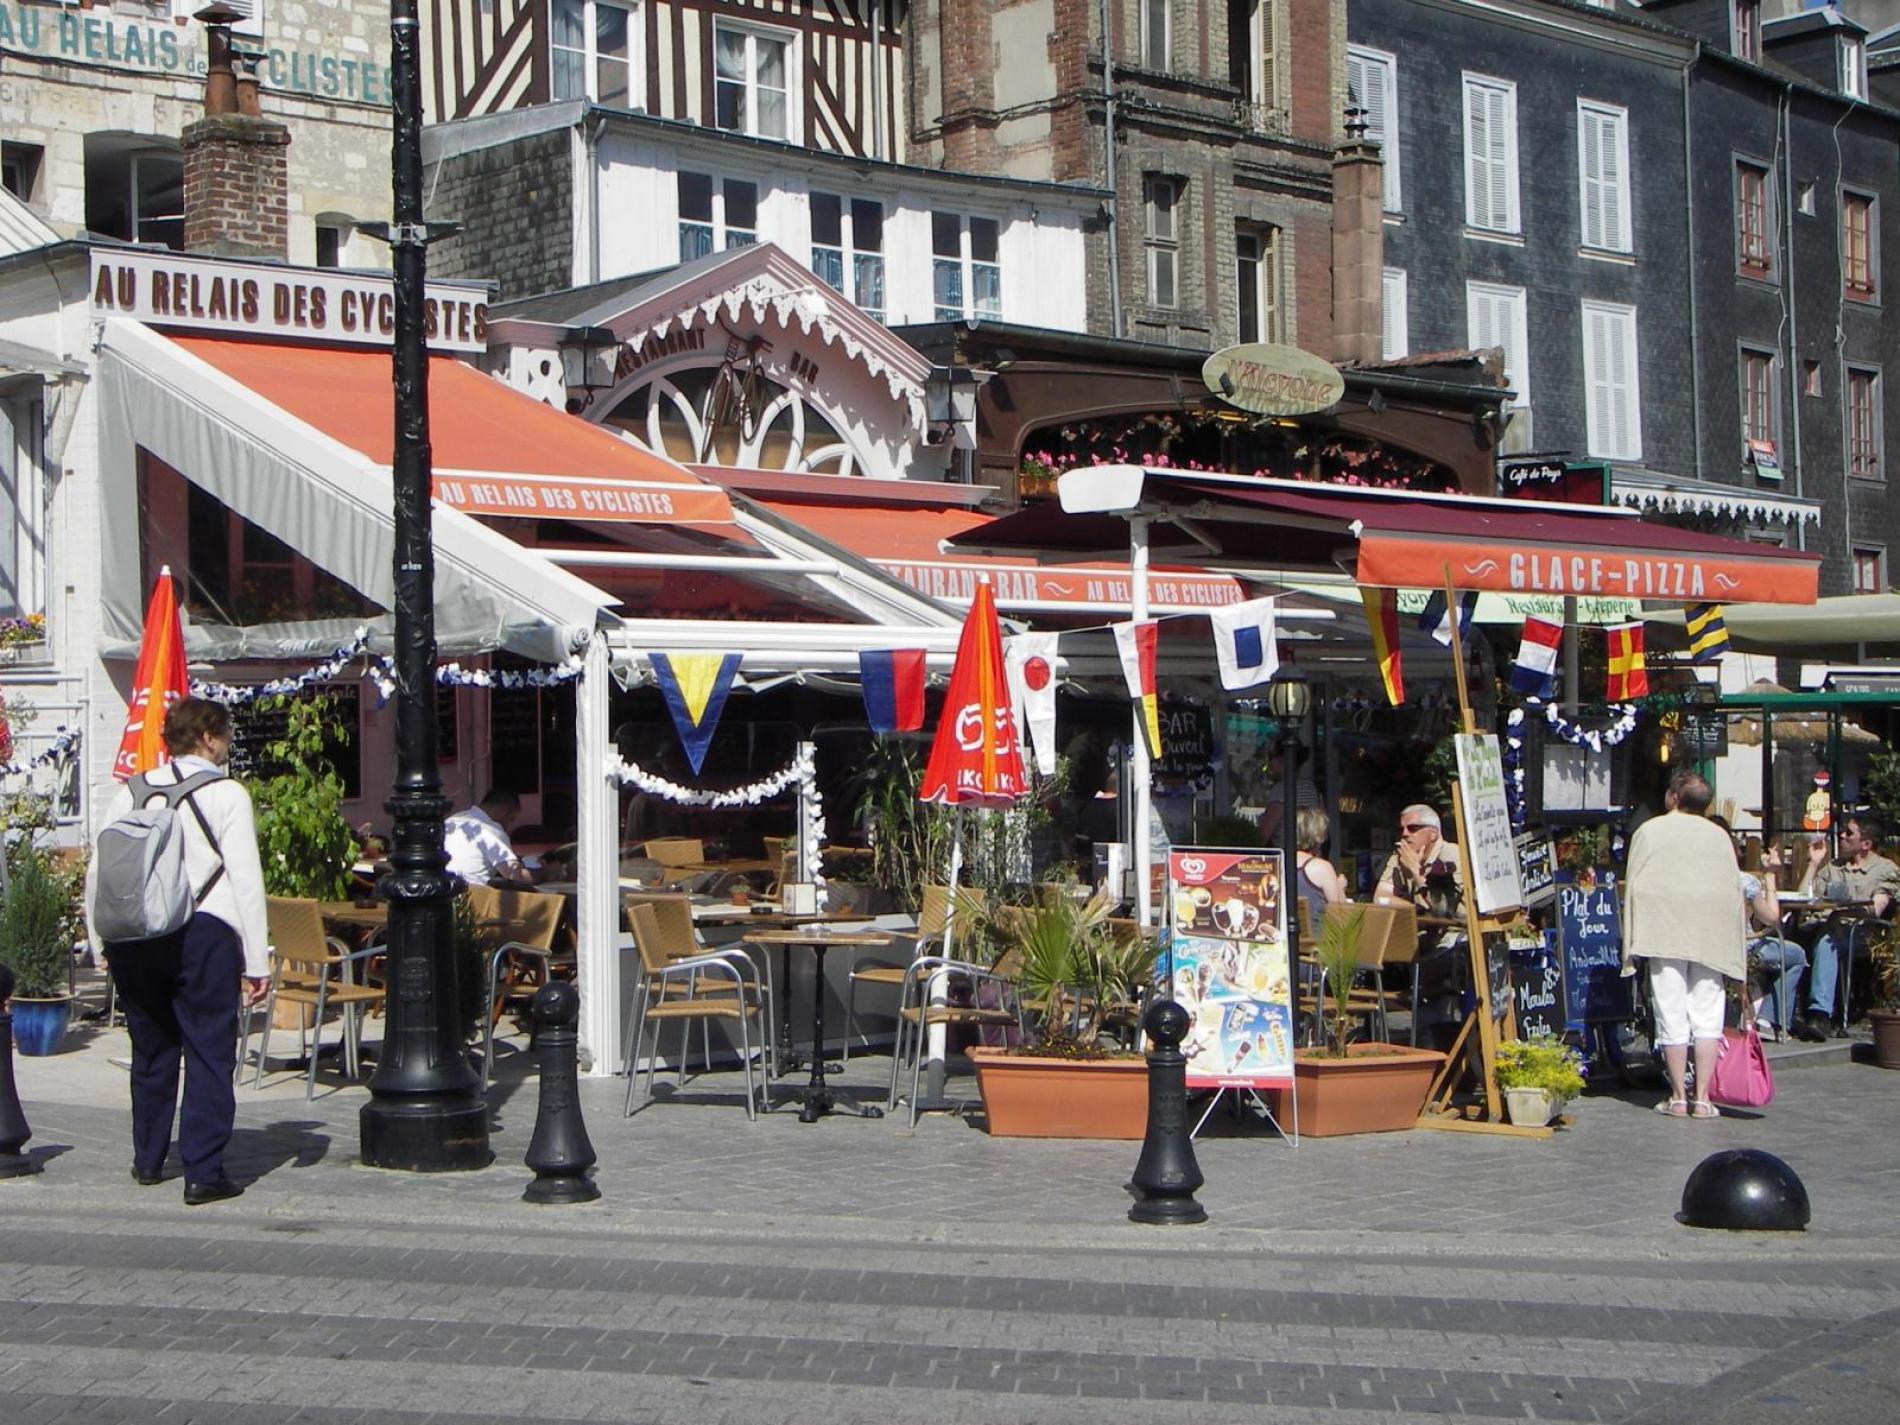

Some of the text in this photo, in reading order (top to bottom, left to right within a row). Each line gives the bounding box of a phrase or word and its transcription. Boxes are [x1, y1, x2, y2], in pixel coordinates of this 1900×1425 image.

[0, 4, 40, 49] AU
[58, 13, 179, 71] RELAIS
[95, 264, 488, 343] AU RELAIS DES CYCSTES
[790, 350, 819, 385] BAR
[1509, 466, 1562, 486] Café de Pays
[440, 482, 674, 516] AU RELAIS DES CYCLISTES
[1088, 580, 1104, 601] AU
[1155, 582, 1179, 604] DES
[1181, 584, 1244, 605] CYCLISTES
[1504, 596, 1564, 614] Restaura
[1159, 709, 1197, 735] BAR
[1561, 887, 1613, 917] Plat du
[1577, 916, 1609, 938] Jour
[1520, 981, 1556, 1011] Moules
[1523, 1014, 1552, 1041] Frites
